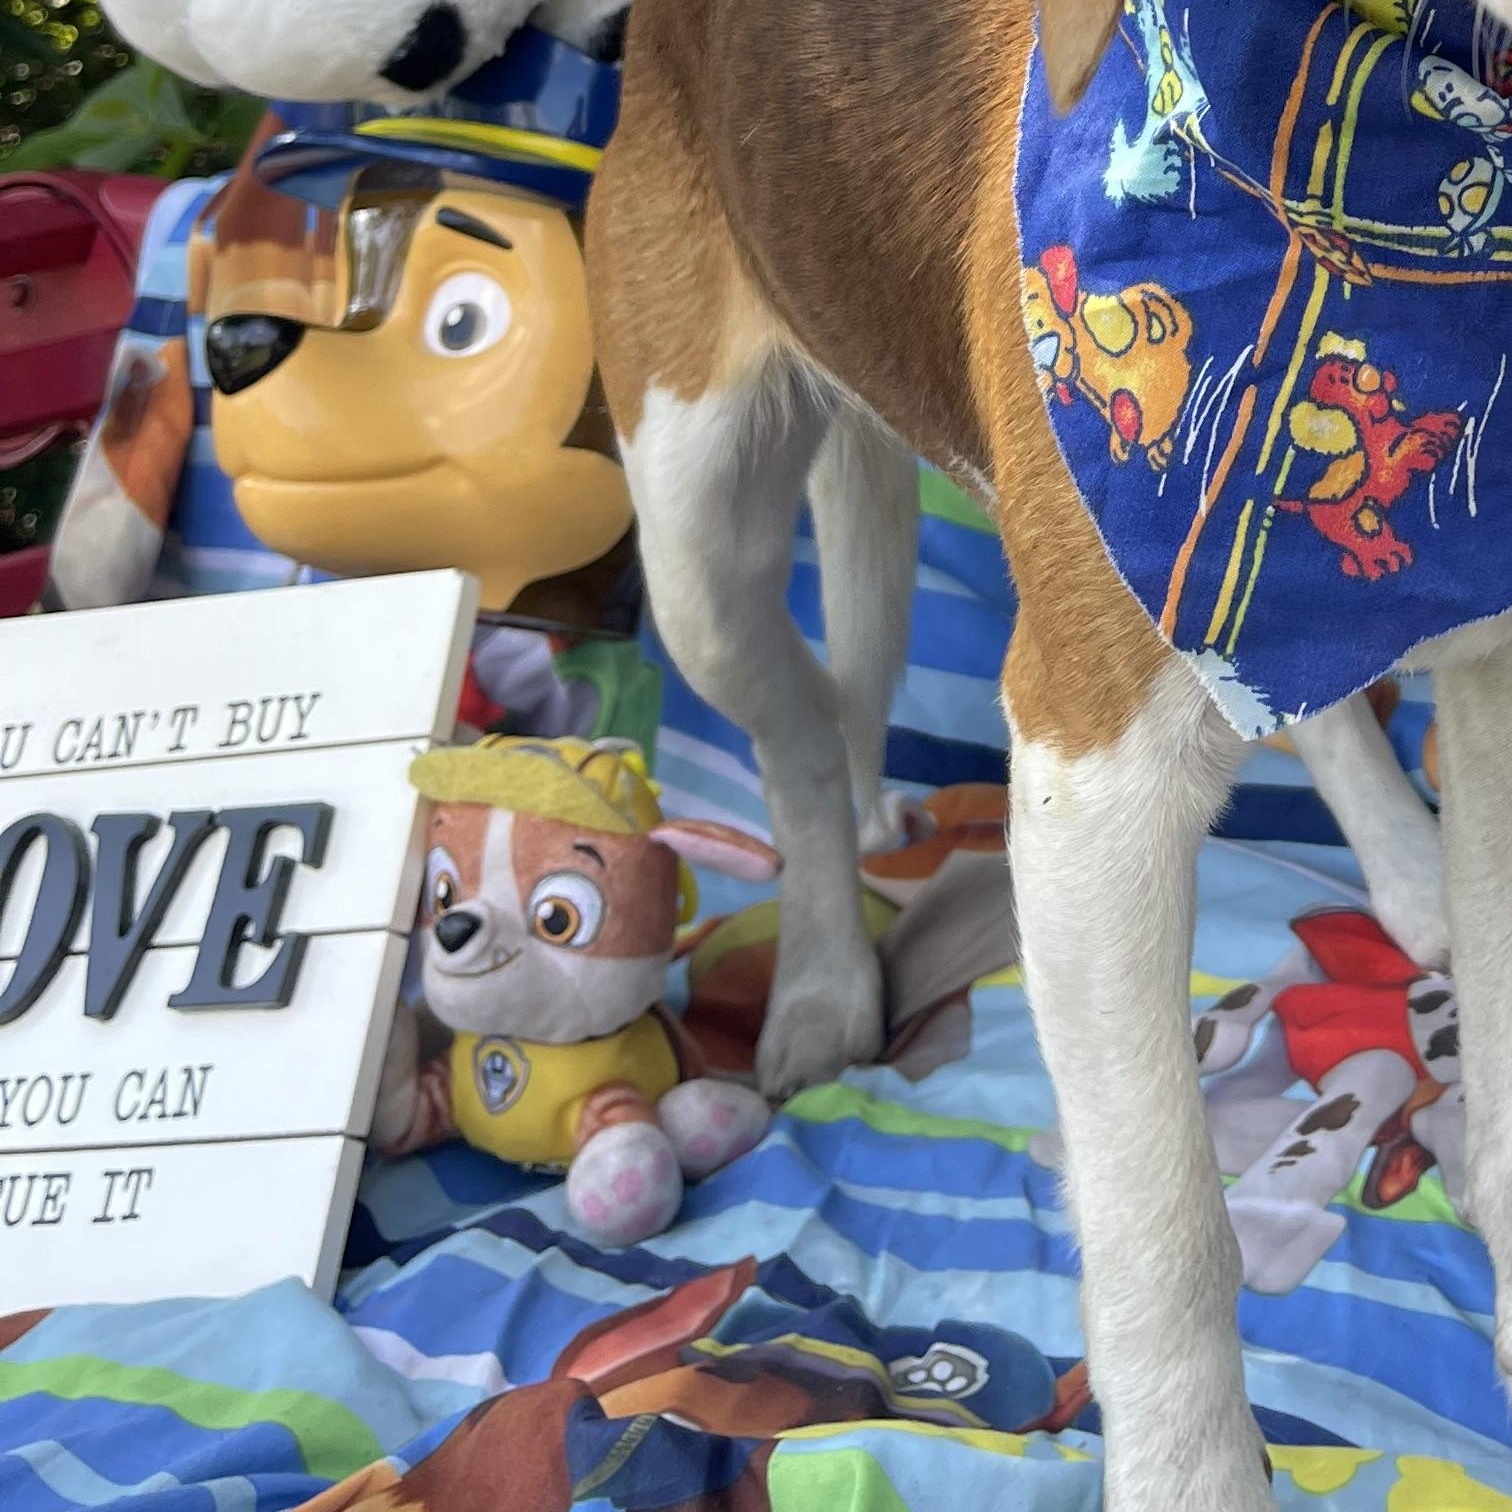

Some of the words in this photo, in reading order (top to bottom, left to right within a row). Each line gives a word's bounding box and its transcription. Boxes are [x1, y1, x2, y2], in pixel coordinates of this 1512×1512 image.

[54, 703, 199, 764] CAN'T
[217, 692, 322, 748] BUY
[0, 1072, 92, 1127] YOU
[114, 1065, 214, 1121] CAN
[0, 1172, 71, 1226] UE
[93, 1166, 154, 1222] IT
